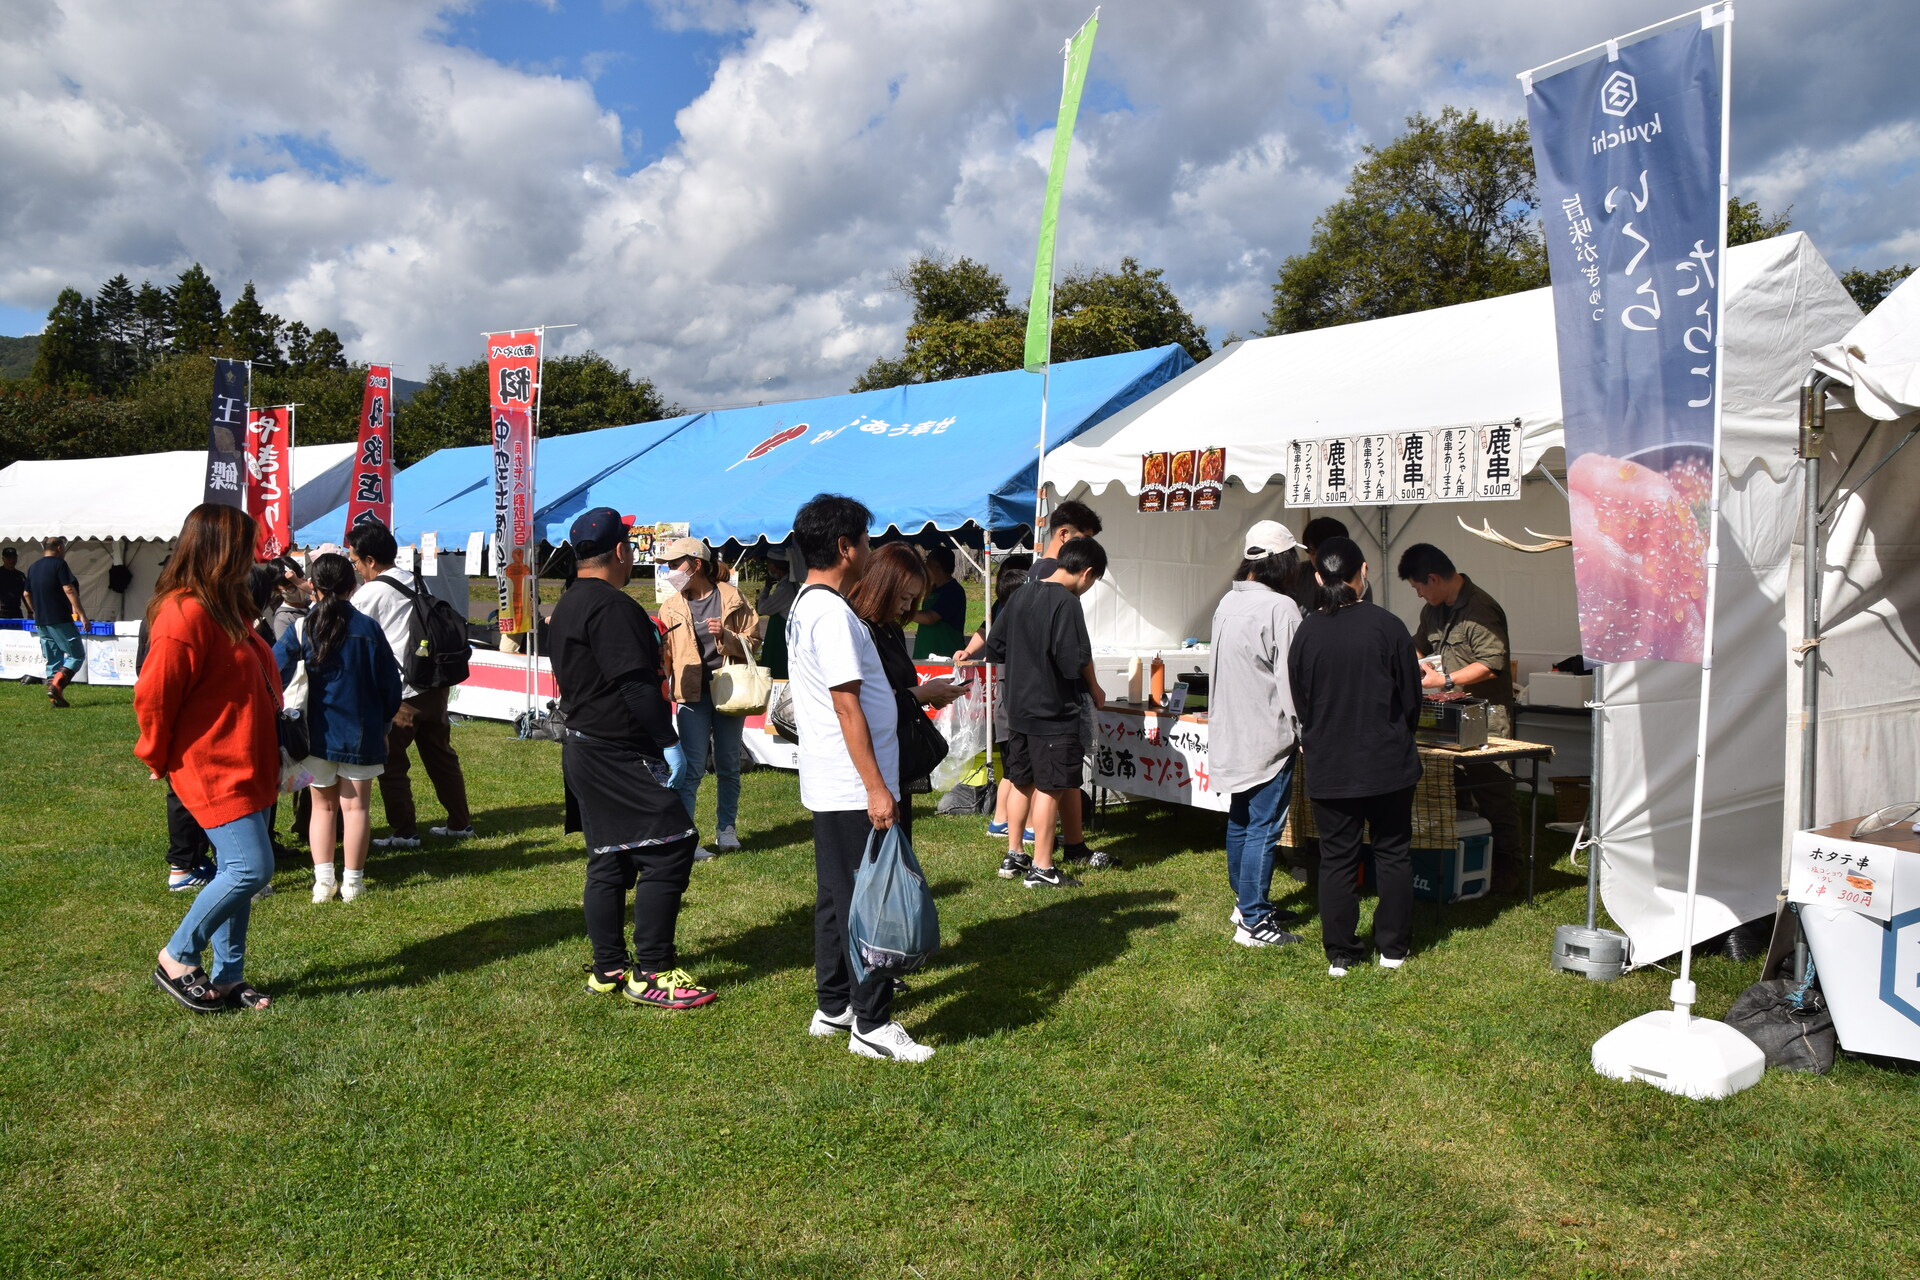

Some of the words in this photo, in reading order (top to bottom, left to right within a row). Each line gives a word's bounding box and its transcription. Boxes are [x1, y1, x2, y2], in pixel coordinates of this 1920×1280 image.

[1303, 444, 1313, 502] ワンちゃん用
[1328, 440, 1346, 491] 鹿串
[1363, 438, 1372, 500] 鹿串あります
[1376, 437, 1385, 499] ワンちゃん用
[1402, 433, 1424, 488] 鹿串
[1443, 430, 1453, 497] 鹿串あります
[1455, 430, 1466, 496] ワンちゃん用
[1487, 426, 1511, 484] 鹿串
[1326, 492, 1347, 502] 500円
[1401, 488, 1425, 499] 500円
[1484, 483, 1511, 495] 500円
[1809, 848, 1870, 870] ホタテ串
[1837, 889, 1872, 907] 300円
